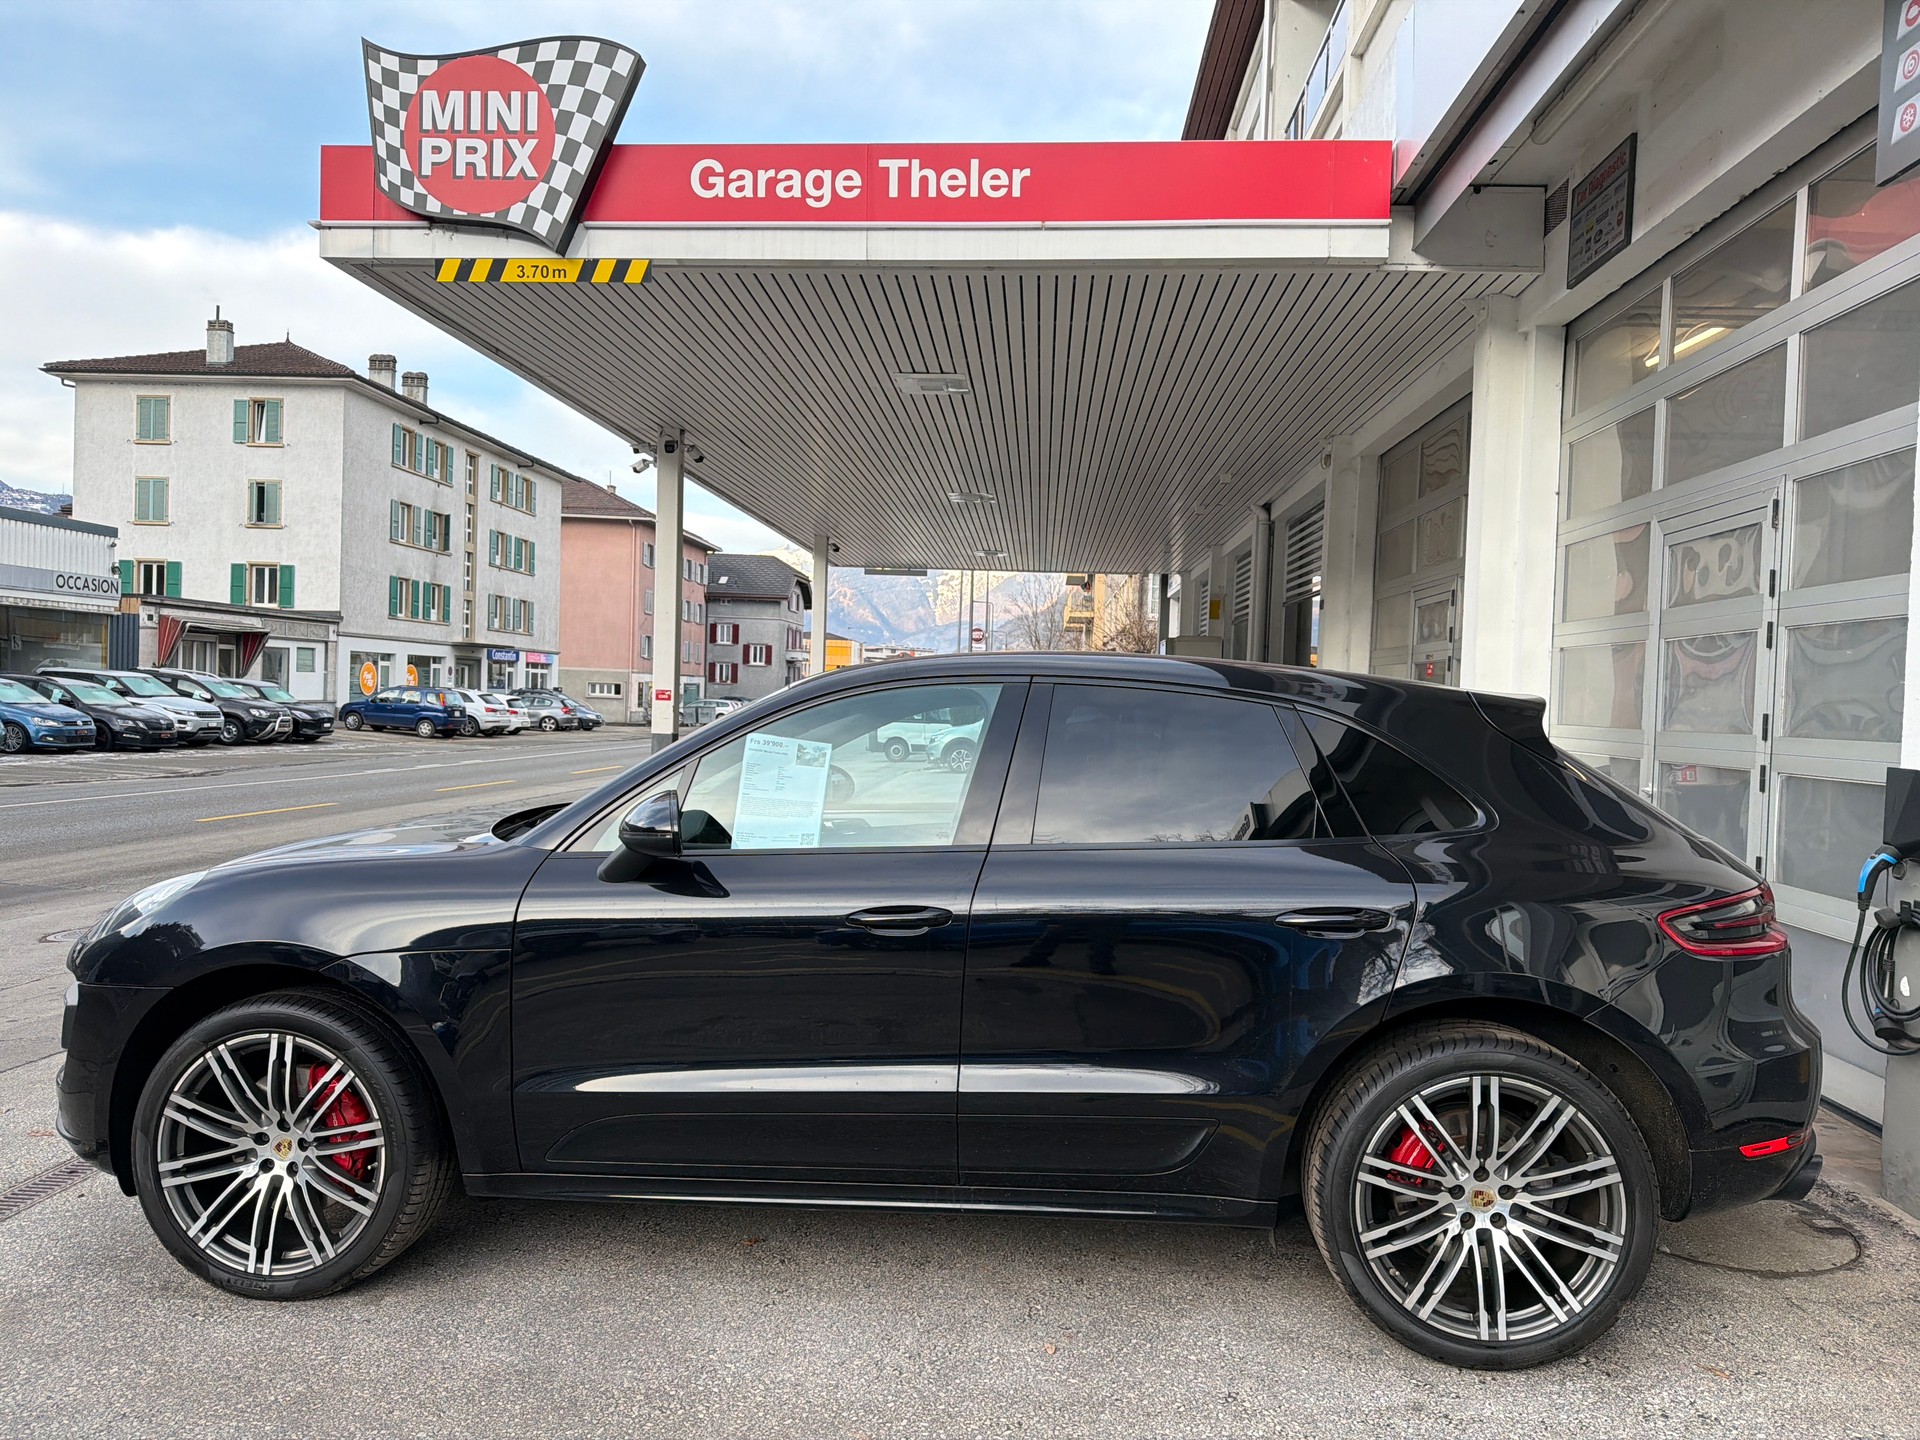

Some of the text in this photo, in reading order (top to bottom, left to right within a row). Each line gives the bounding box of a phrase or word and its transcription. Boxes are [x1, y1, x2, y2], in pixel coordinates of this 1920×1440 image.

[420, 90, 539, 133] MINI
[419, 138, 539, 179] PRIX
[1588, 151, 1627, 196] Diagnostic
[690, 158, 1031, 208] Garage Theler
[56, 574, 119, 595] OCCASION
[492, 649, 517, 661] Constantin
